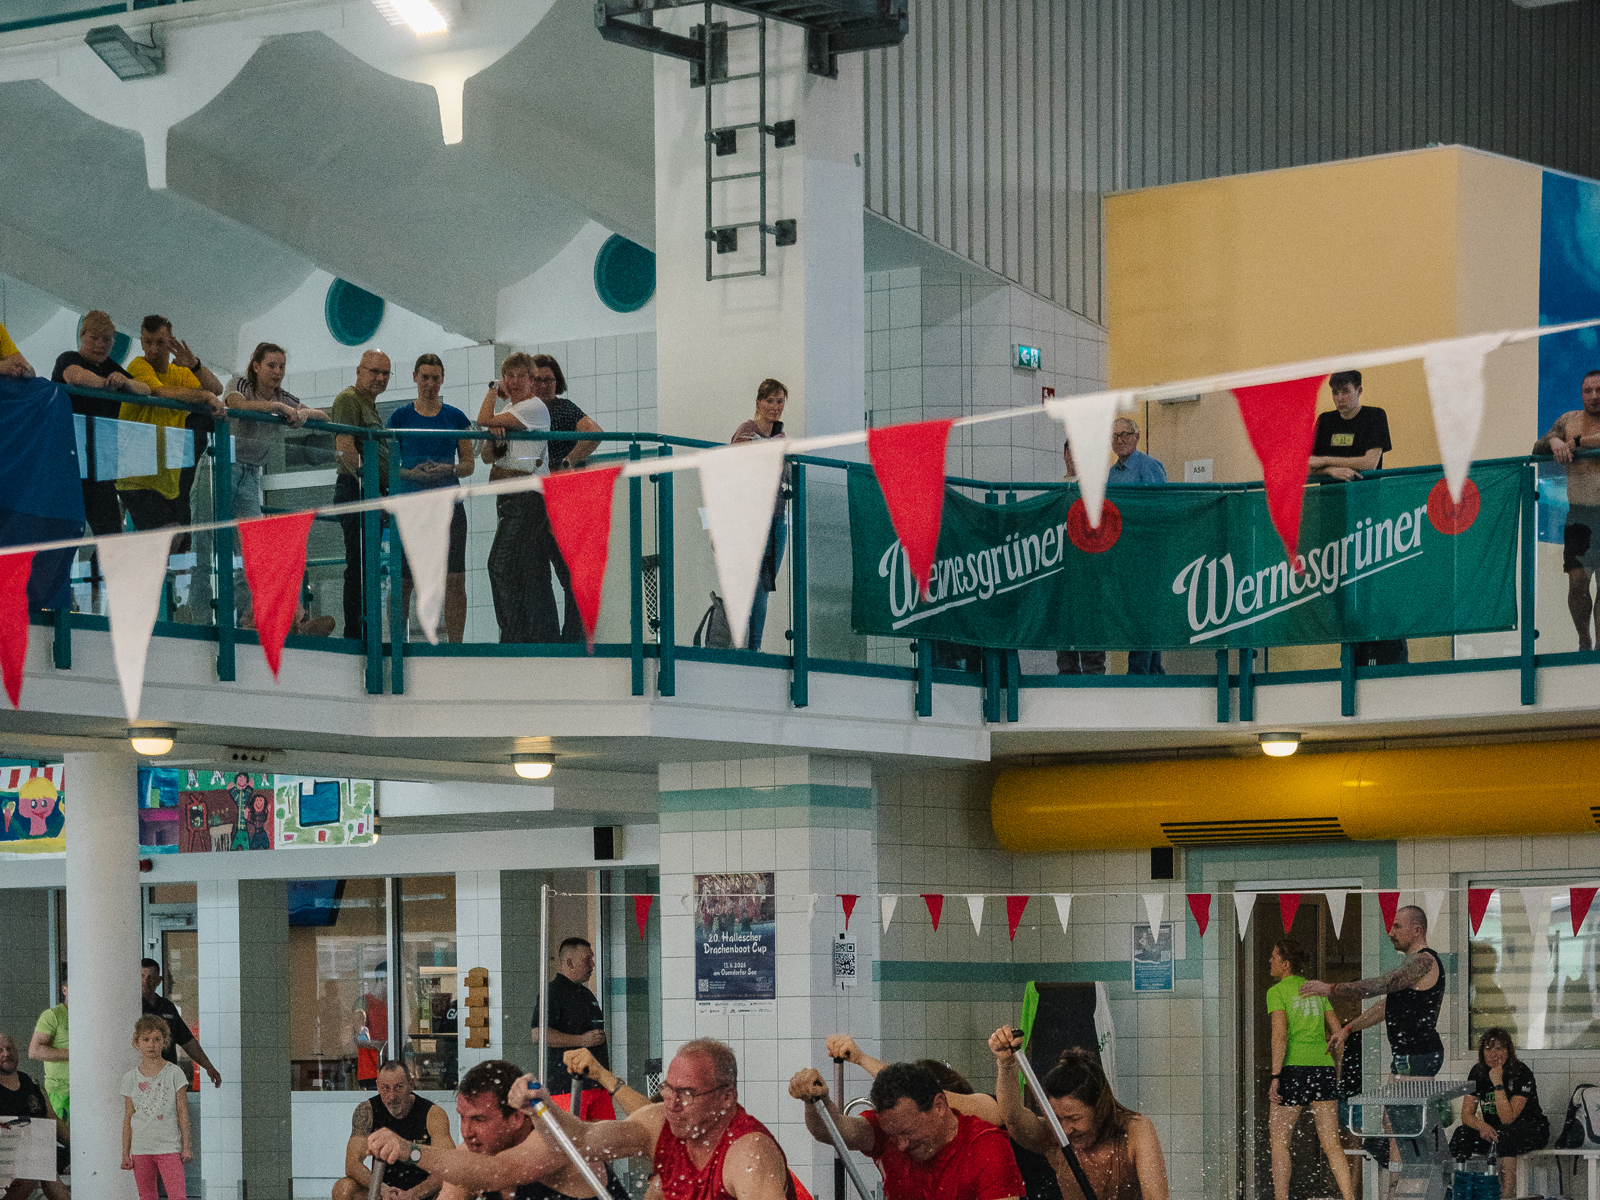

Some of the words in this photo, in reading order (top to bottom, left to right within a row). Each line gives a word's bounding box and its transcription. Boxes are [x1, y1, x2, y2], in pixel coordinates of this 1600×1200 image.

[1172, 504, 1427, 633] Wernesgrüner
[708, 933, 720, 943] 20.
[722, 931, 762, 943] Hallescher
[703, 942, 750, 954] Drachenboot
[752, 942, 767, 955] Cup
